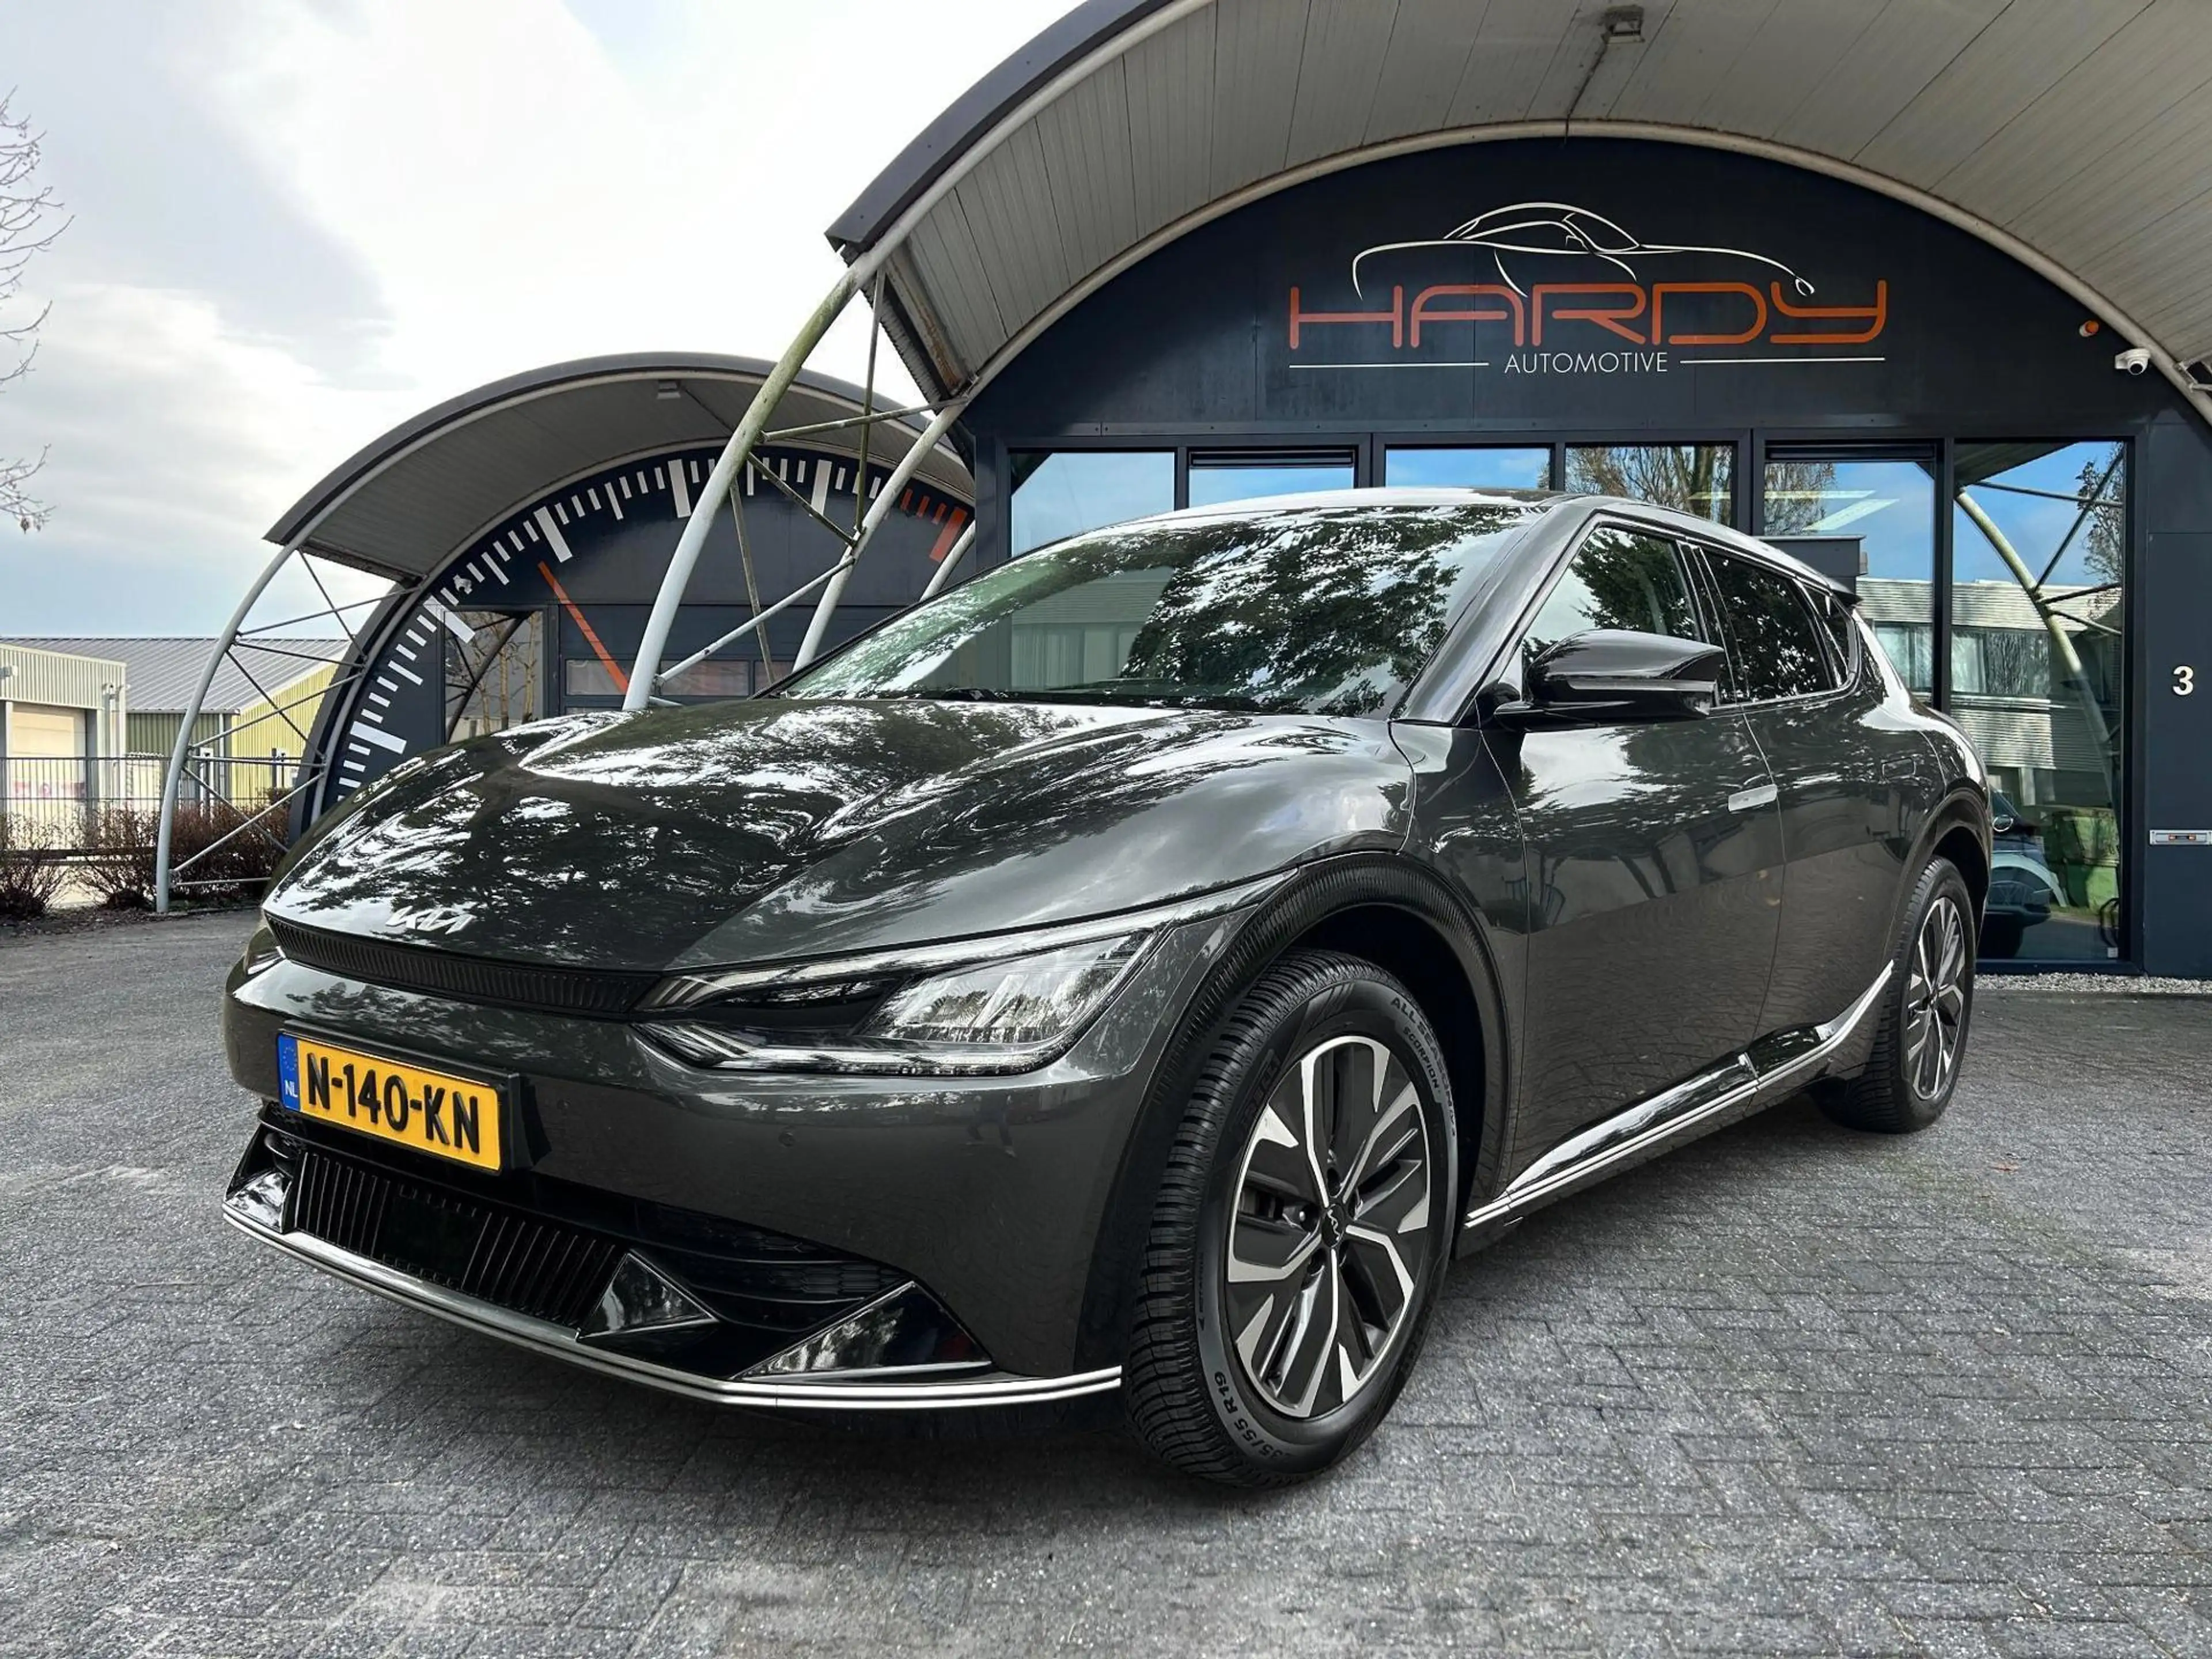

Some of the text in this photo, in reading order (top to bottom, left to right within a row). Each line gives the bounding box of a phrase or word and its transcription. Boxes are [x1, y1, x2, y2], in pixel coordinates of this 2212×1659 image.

[1289, 279, 1887, 349] HARDY
[1504, 351, 1668, 373] AUTOMOTIVE
[2172, 665, 2194, 695] 3
[1391, 997, 1416, 1024] ALL
[1403, 1025, 1439, 1089] SCORPION
[285, 1078, 298, 1098] NL
[306, 1052, 480, 1154] N-140-KN
[1214, 1371, 1291, 1459] 35/55 R19
